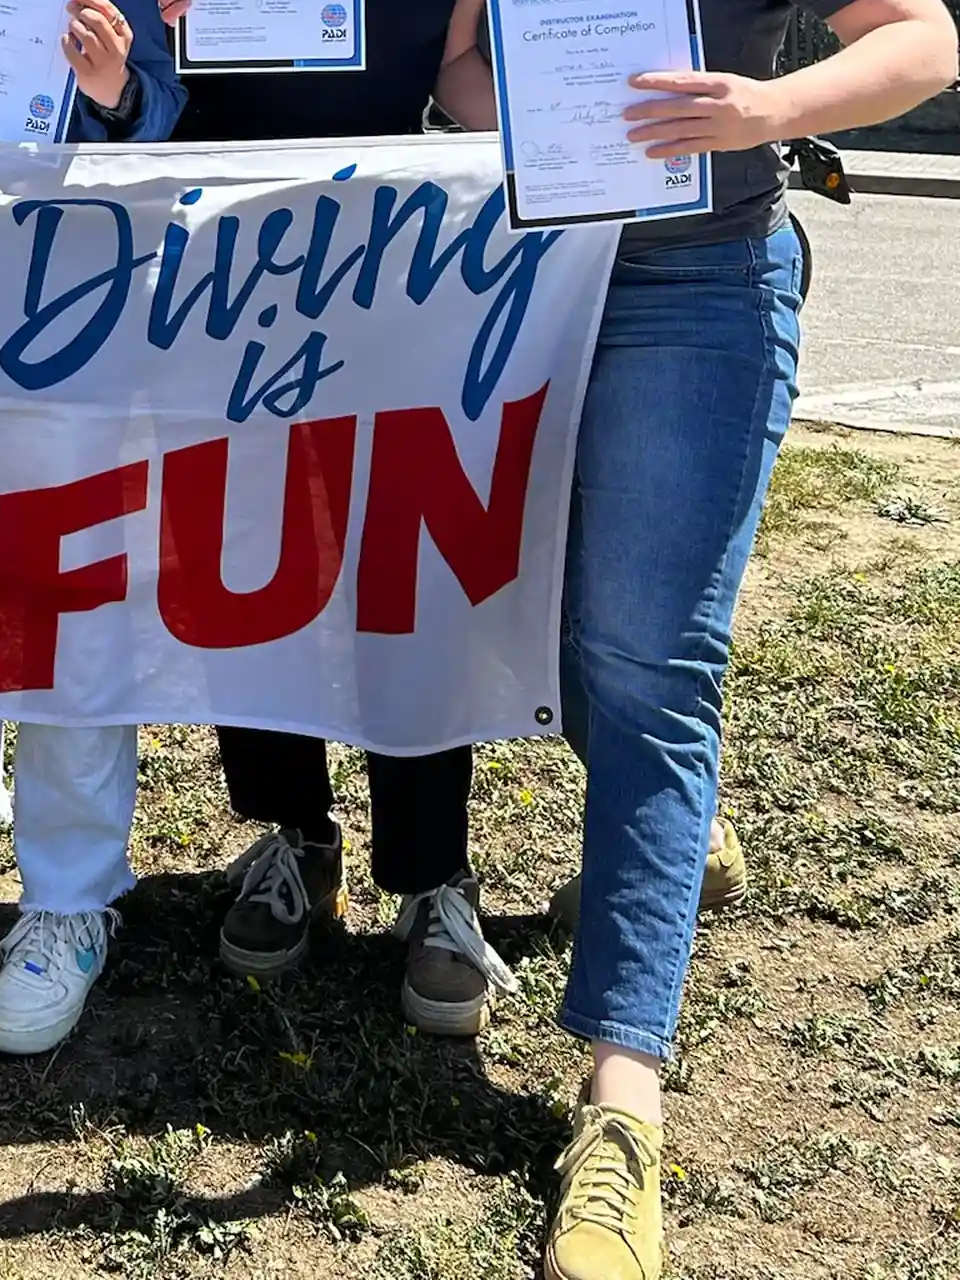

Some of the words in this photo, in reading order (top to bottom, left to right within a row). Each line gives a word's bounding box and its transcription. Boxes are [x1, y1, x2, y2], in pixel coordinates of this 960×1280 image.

[540, 16, 584, 26] INSTRUCTOR
[586, 11, 638, 22] EXAMINATION
[322, 28, 347, 39] PADI
[522, 27, 578, 42] Certificate
[580, 24, 592, 37] of
[595, 20, 656, 36] Completion
[25, 117, 50, 132] PADI
[665, 173, 692, 186] PADI
[226, 303, 345, 423] is
